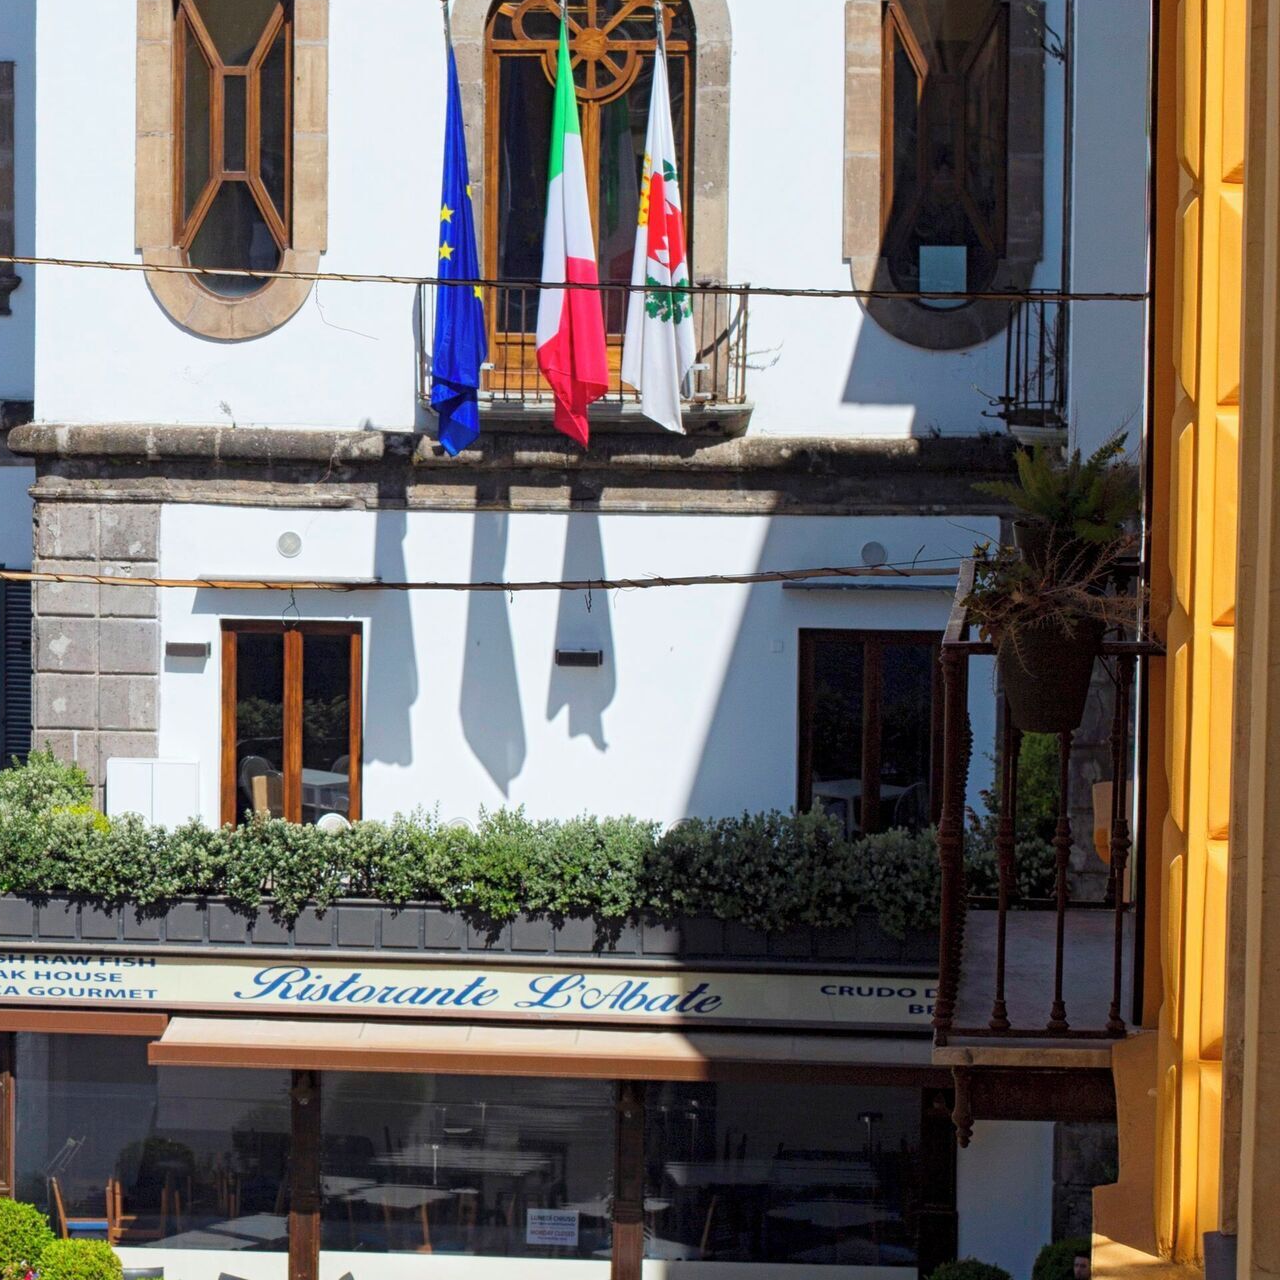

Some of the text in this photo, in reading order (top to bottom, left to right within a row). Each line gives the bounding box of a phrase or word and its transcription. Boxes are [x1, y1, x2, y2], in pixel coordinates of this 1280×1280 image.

[34, 955, 92, 965] RAW
[99, 956, 156, 967] FISH
[34, 971, 122, 983] HOUSE
[28, 986, 158, 999] GOURMET
[234, 965, 724, 1015] Ristorante L'Abate
[821, 984, 917, 999] CRUDO
